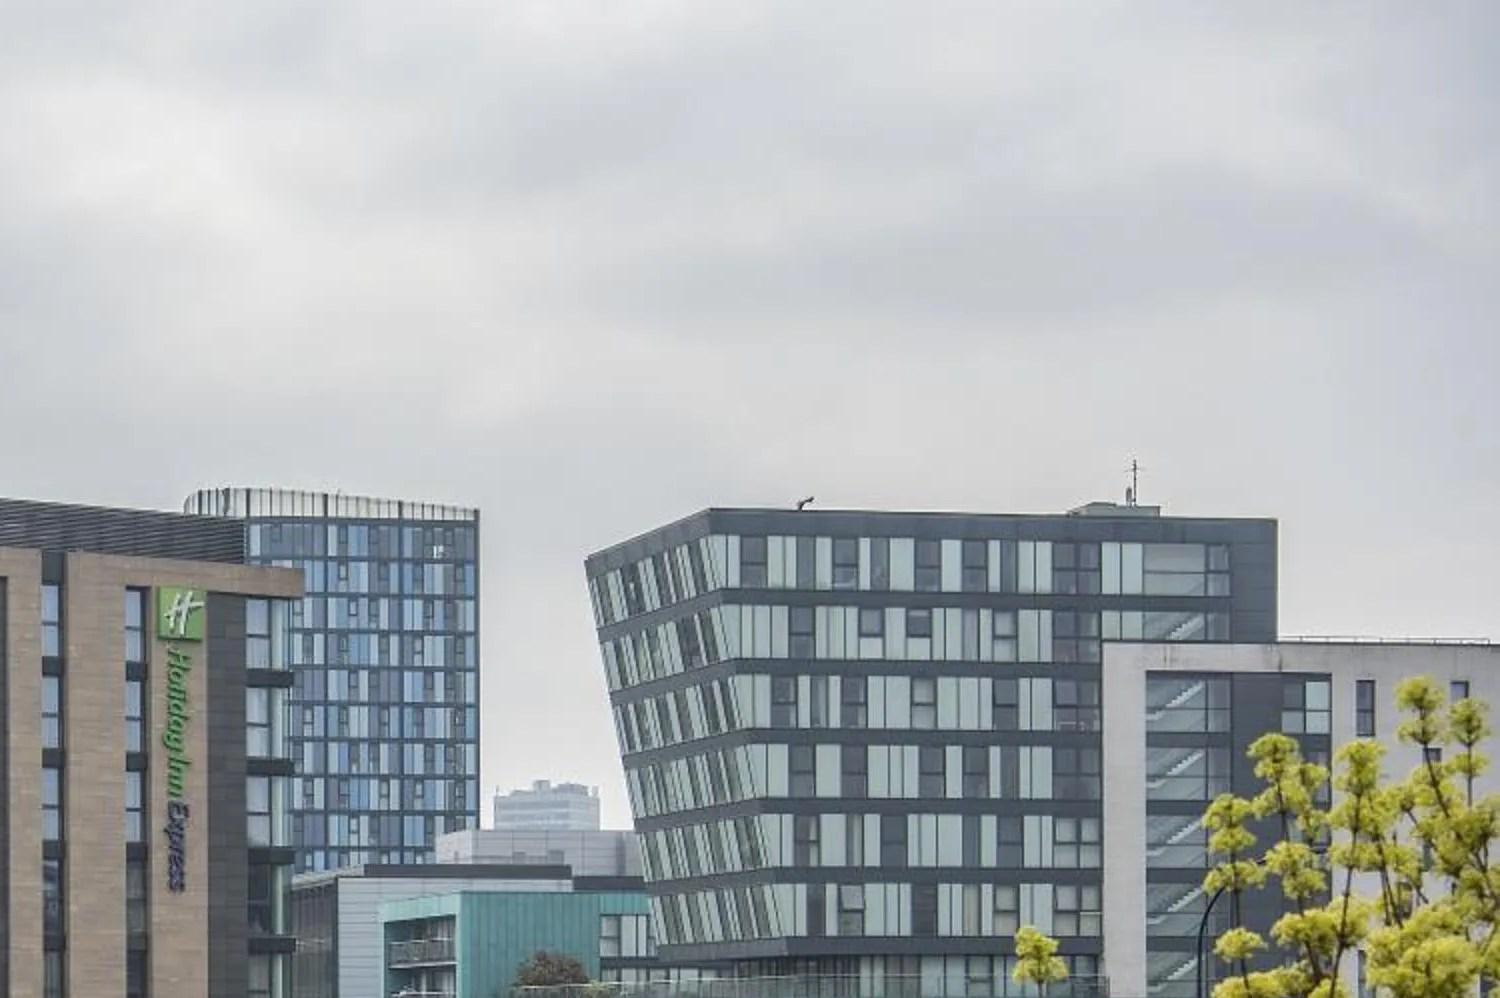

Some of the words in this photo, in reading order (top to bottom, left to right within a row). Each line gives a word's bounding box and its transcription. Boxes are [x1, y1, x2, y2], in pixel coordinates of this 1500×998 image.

[163, 648, 192, 751] Holiday
[168, 756, 192, 797] Inn
[164, 801, 190, 892] Express
